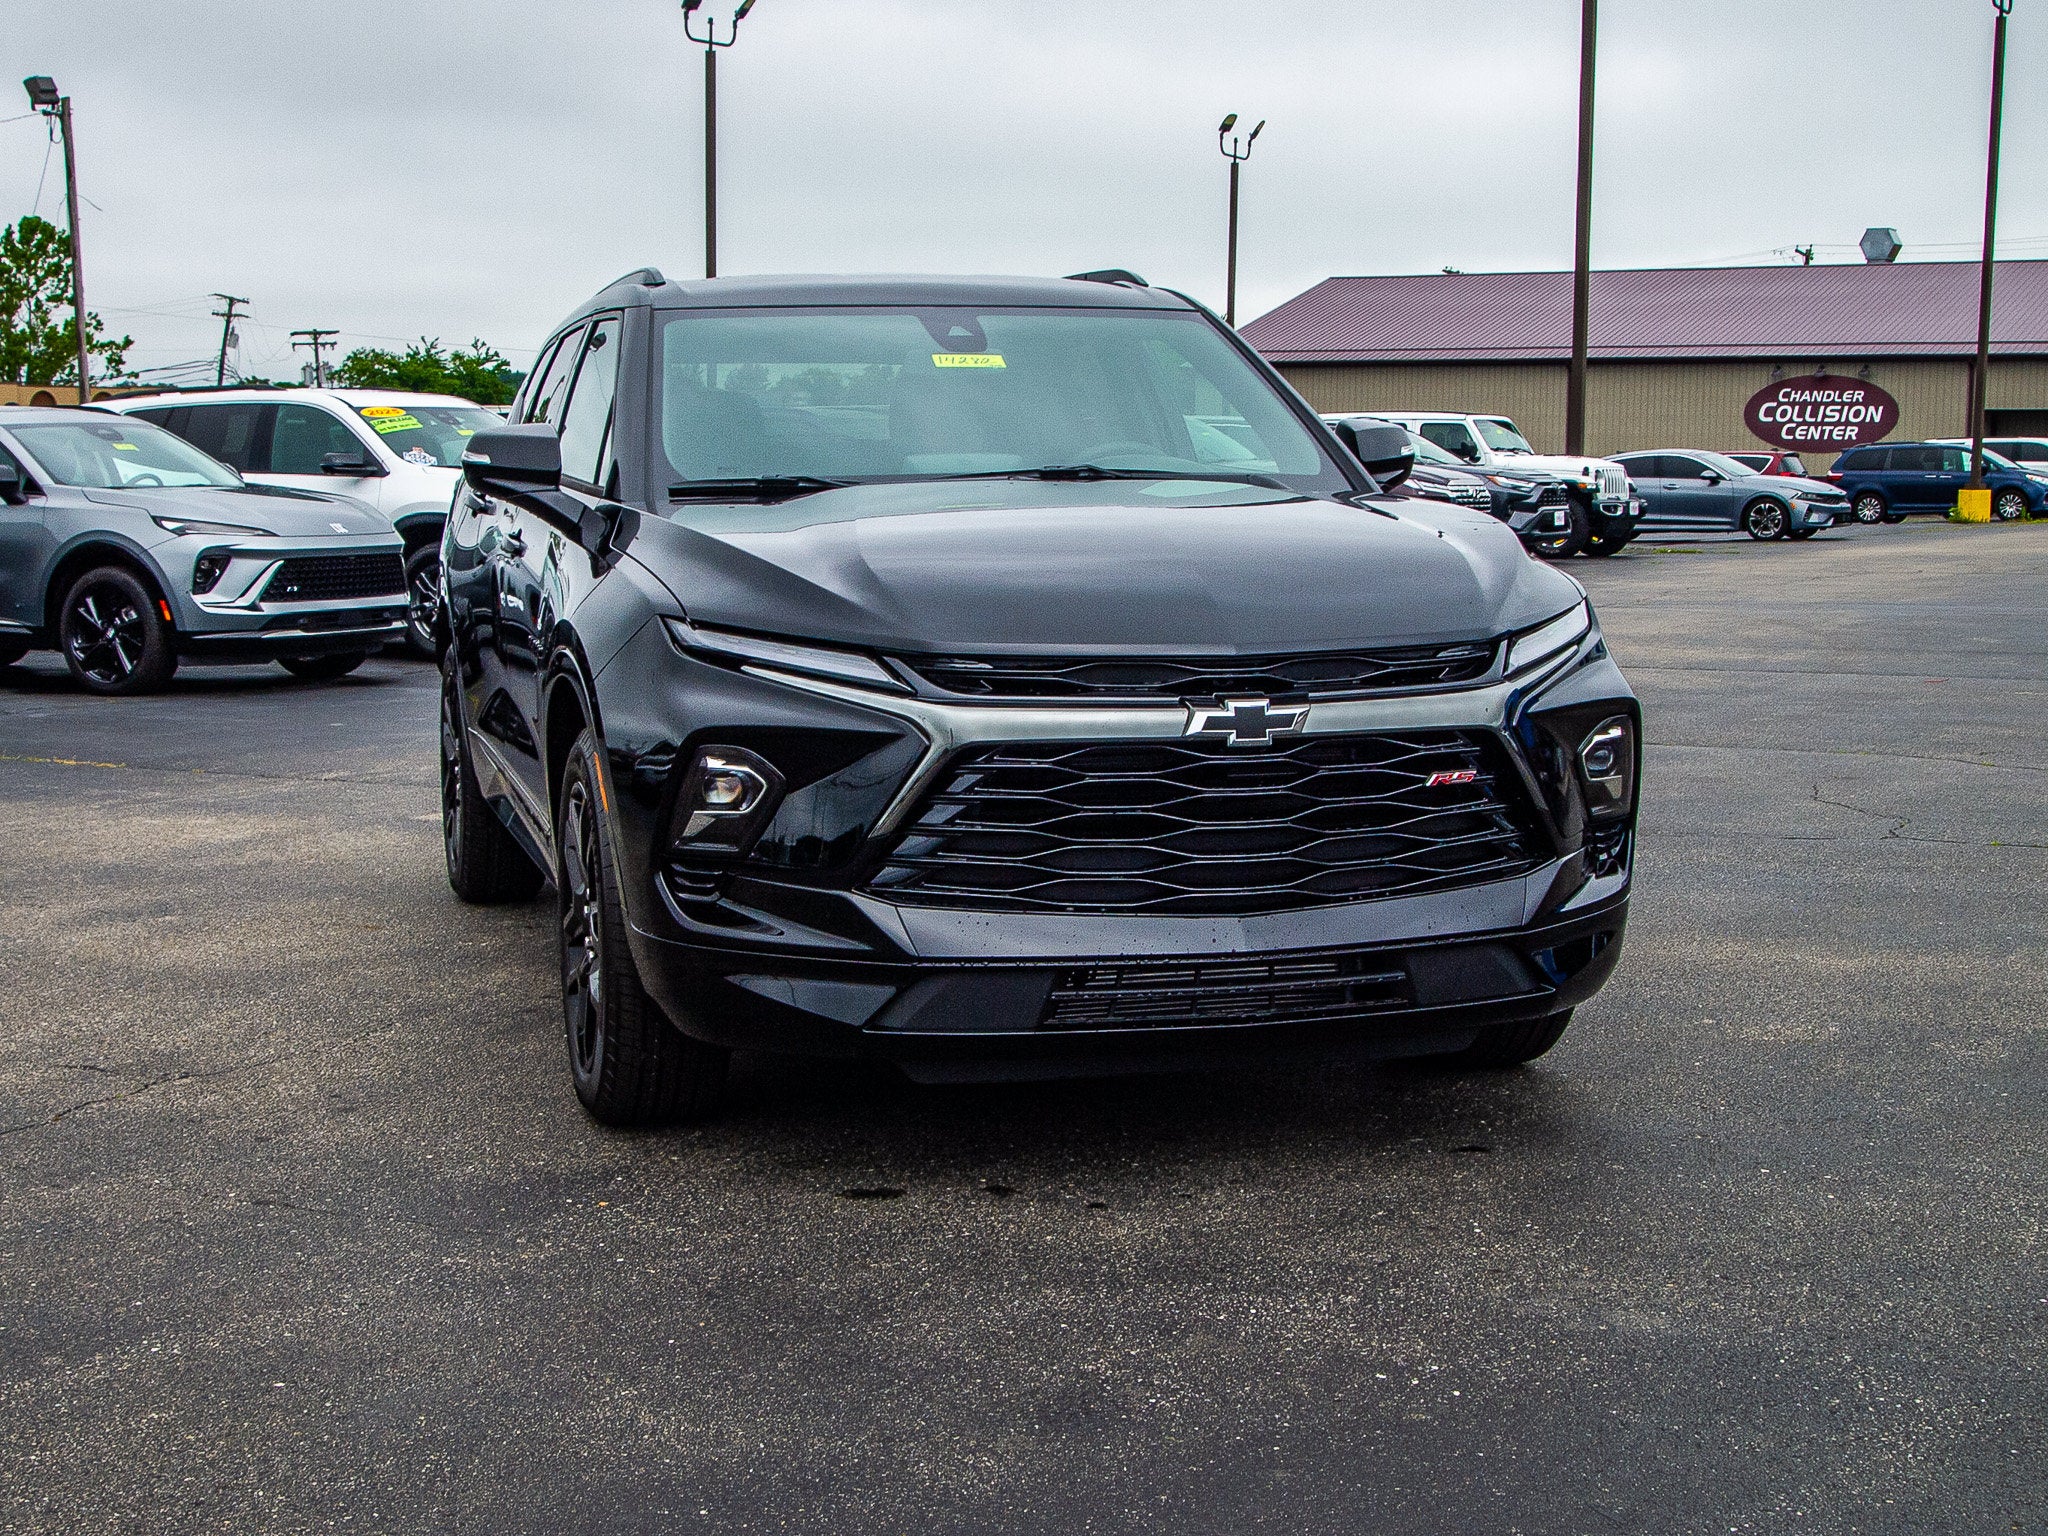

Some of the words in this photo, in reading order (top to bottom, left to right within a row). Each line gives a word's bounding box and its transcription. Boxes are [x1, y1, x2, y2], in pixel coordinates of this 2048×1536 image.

[1778, 388, 1864, 402] CHANDLER
[367, 408, 400, 416] 2025
[1758, 402, 1884, 423] COLLISION
[1780, 423, 1859, 440] CENTER
[1425, 770, 1477, 787] RS
